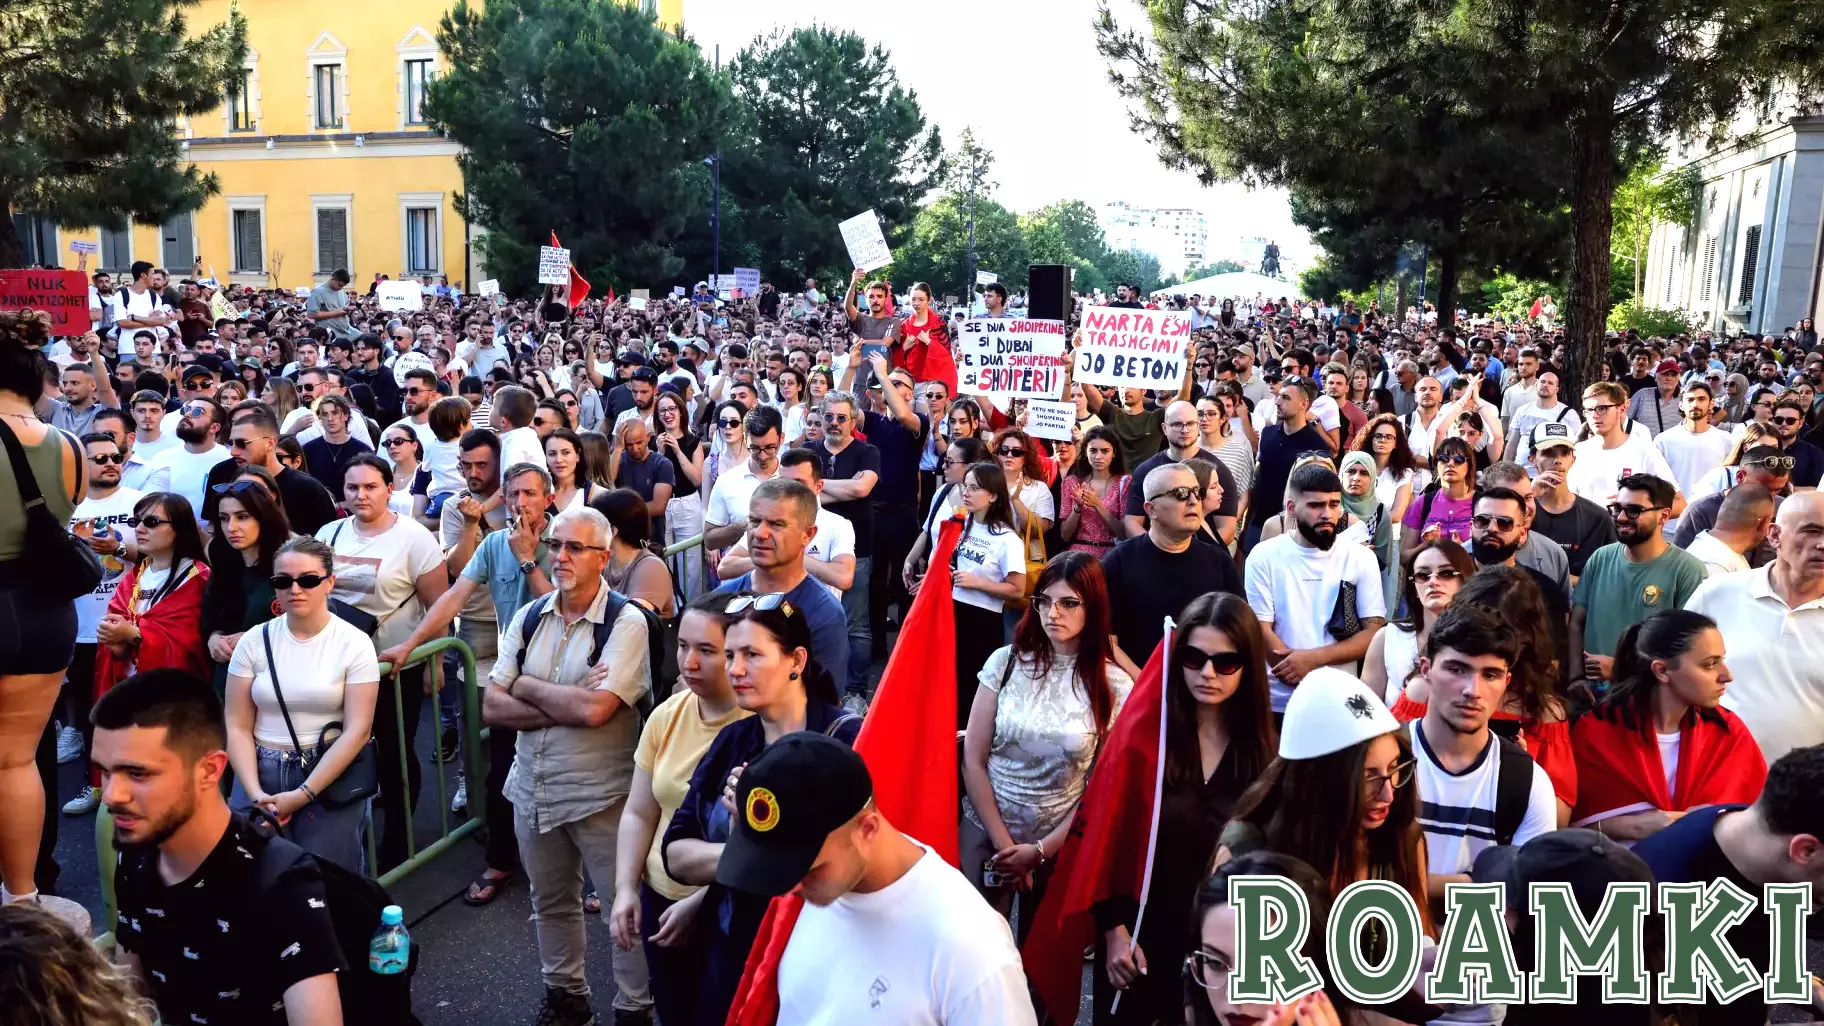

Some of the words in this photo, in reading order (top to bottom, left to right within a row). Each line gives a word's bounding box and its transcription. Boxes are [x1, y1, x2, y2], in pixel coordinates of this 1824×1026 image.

[28, 277, 67, 290] NUK
[3, 295, 86, 307] PRIVATIZOHET
[964, 322, 982, 333] SE
[987, 322, 1005, 333] DUA
[1086, 311, 1153, 334] NARTA
[1088, 331, 1178, 354] TRASHGIMI
[964, 354, 973, 366] E
[980, 354, 1003, 366] DUA
[1081, 352, 1105, 373] JO
[1112, 354, 1178, 380] BETON
